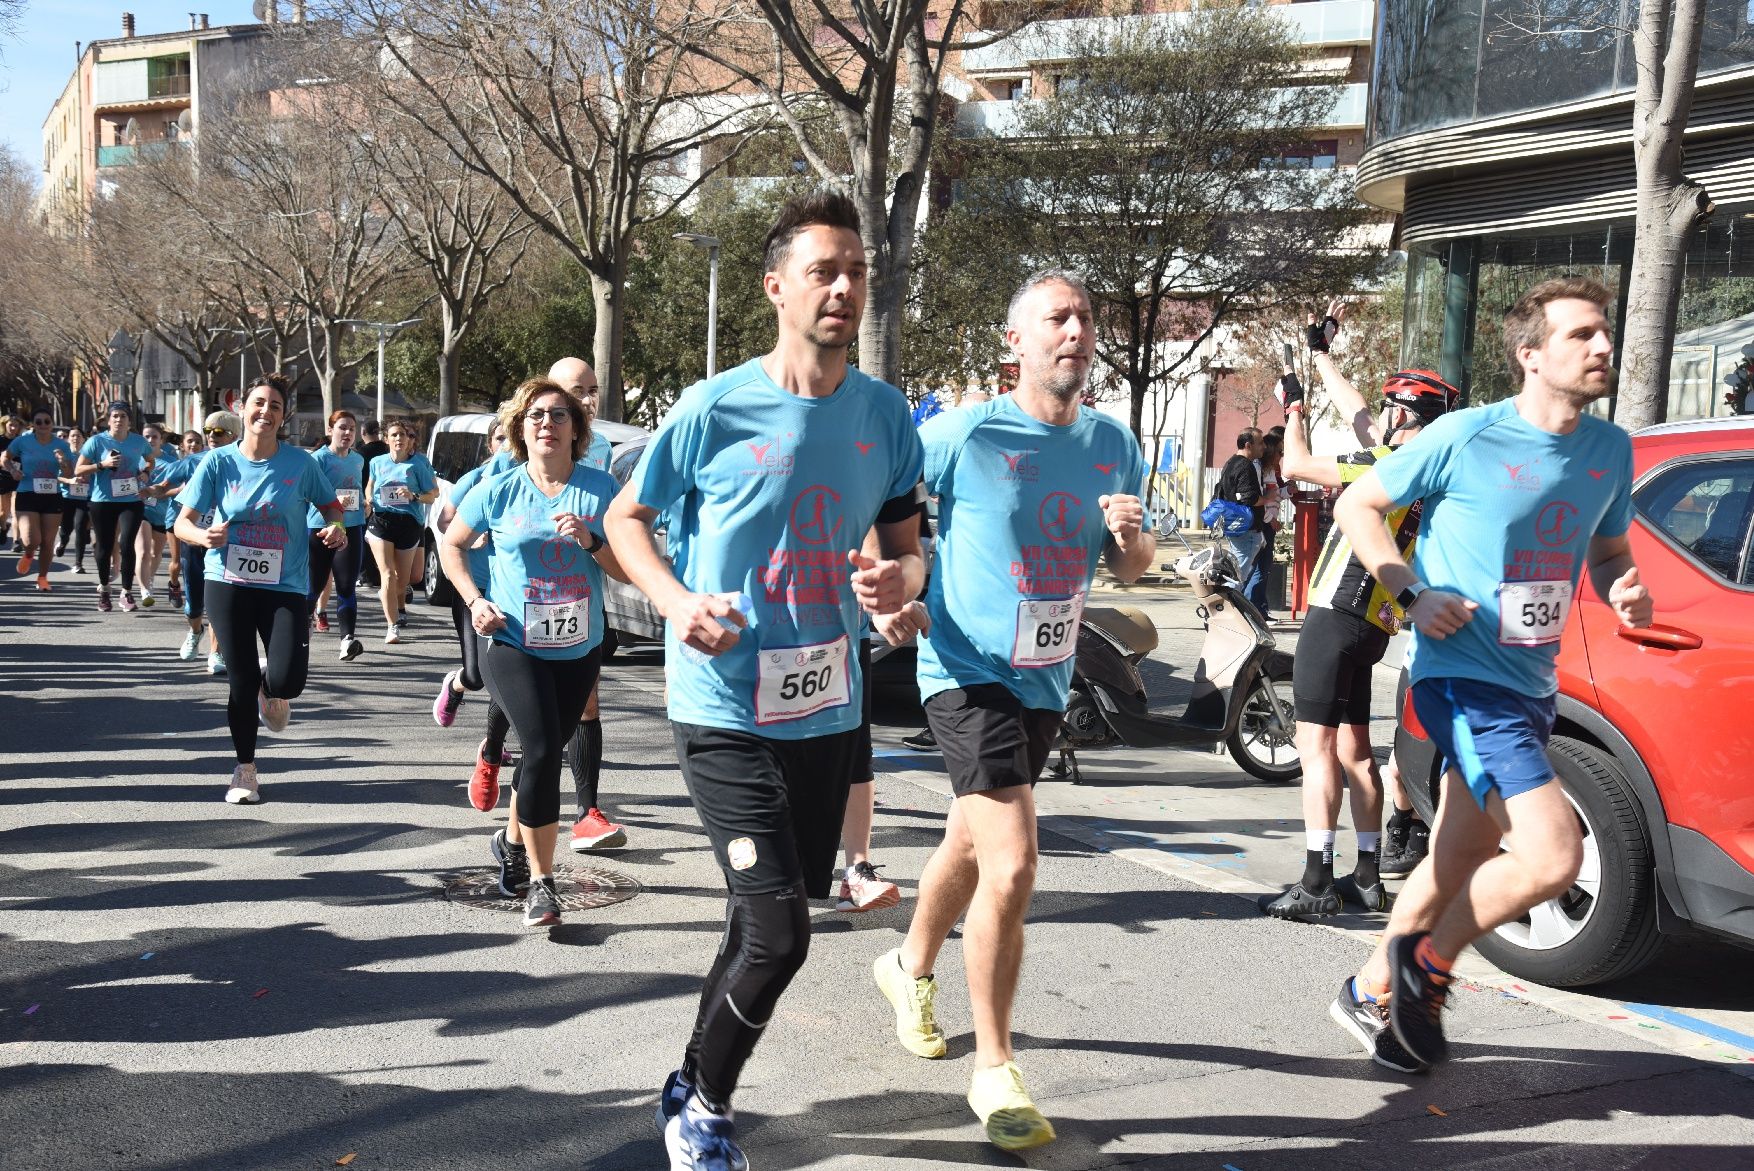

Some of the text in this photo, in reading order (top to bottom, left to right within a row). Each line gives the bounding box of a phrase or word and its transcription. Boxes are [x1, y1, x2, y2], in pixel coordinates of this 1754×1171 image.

[120, 484, 131, 492] 22
[237, 557, 269, 574] 706
[1535, 550, 1574, 566] CURS
[1010, 561, 1088, 578] DE LA DON
[1545, 566, 1571, 580] DON
[1017, 578, 1083, 595] MANRES
[1521, 601, 1560, 627] 534
[541, 617, 578, 636] 173
[1036, 618, 1075, 648] 697
[780, 665, 832, 701] 560
